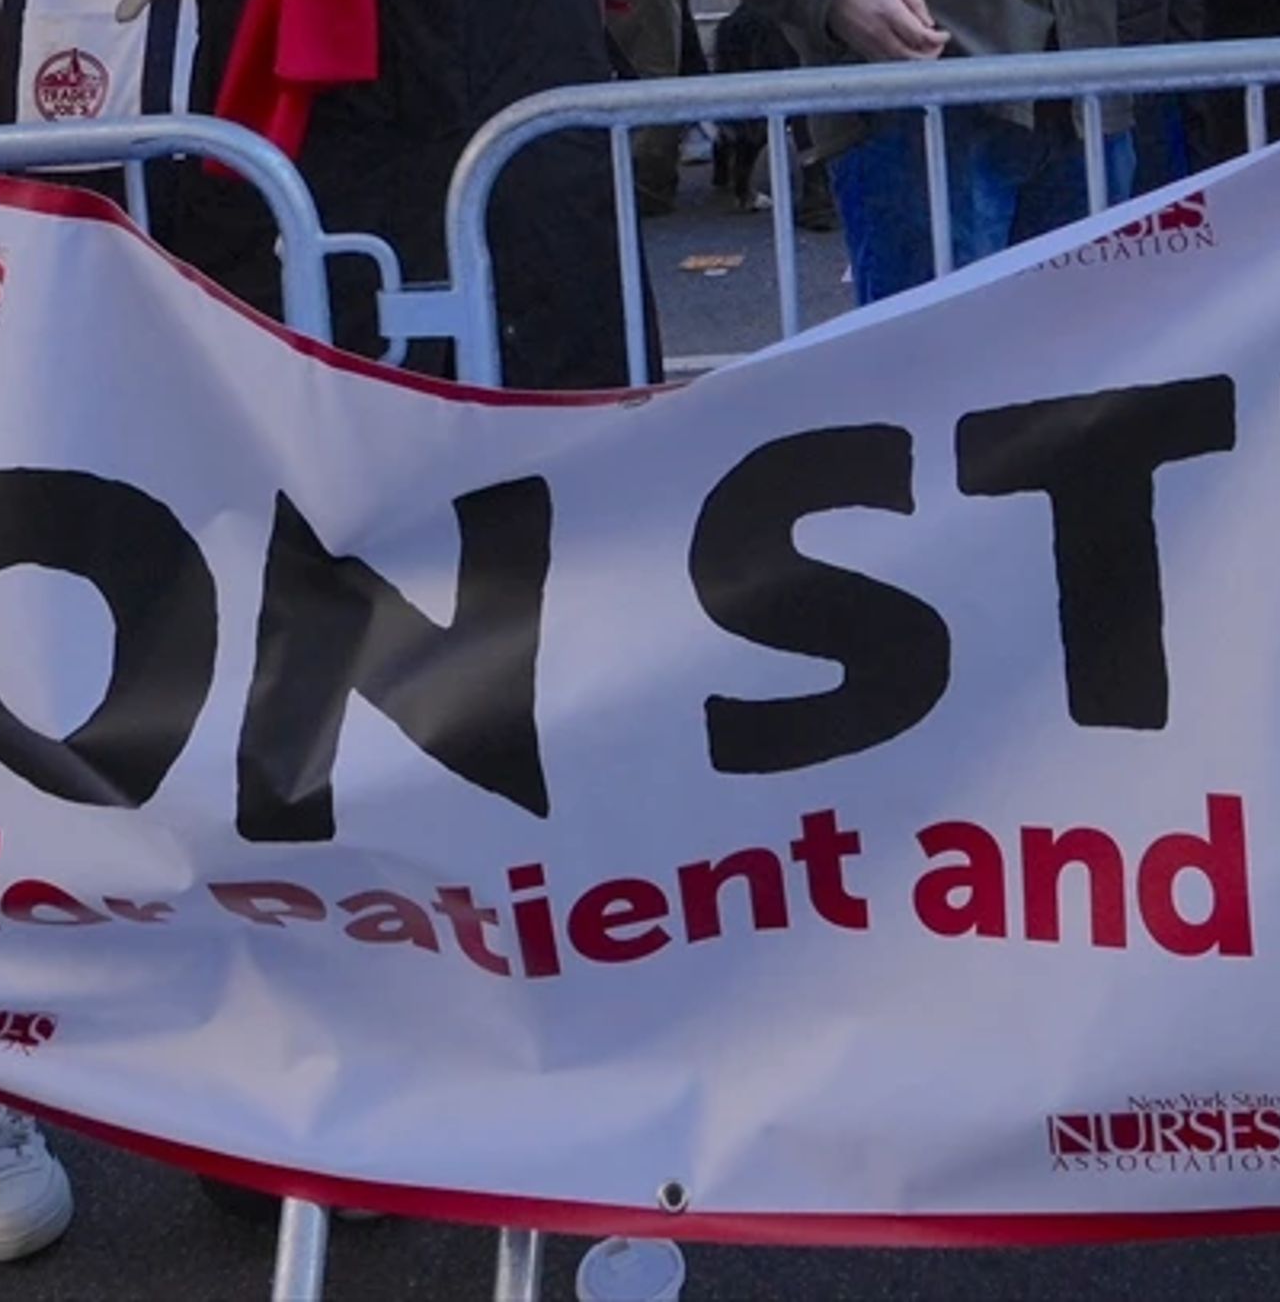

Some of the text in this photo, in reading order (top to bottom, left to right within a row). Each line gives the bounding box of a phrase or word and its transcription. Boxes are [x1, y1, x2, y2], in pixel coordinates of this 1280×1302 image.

[207, 808, 869, 979] Patient
[912, 792, 1255, 958] and
[1127, 1095, 1174, 1112] New
[1178, 1092, 1225, 1110] York
